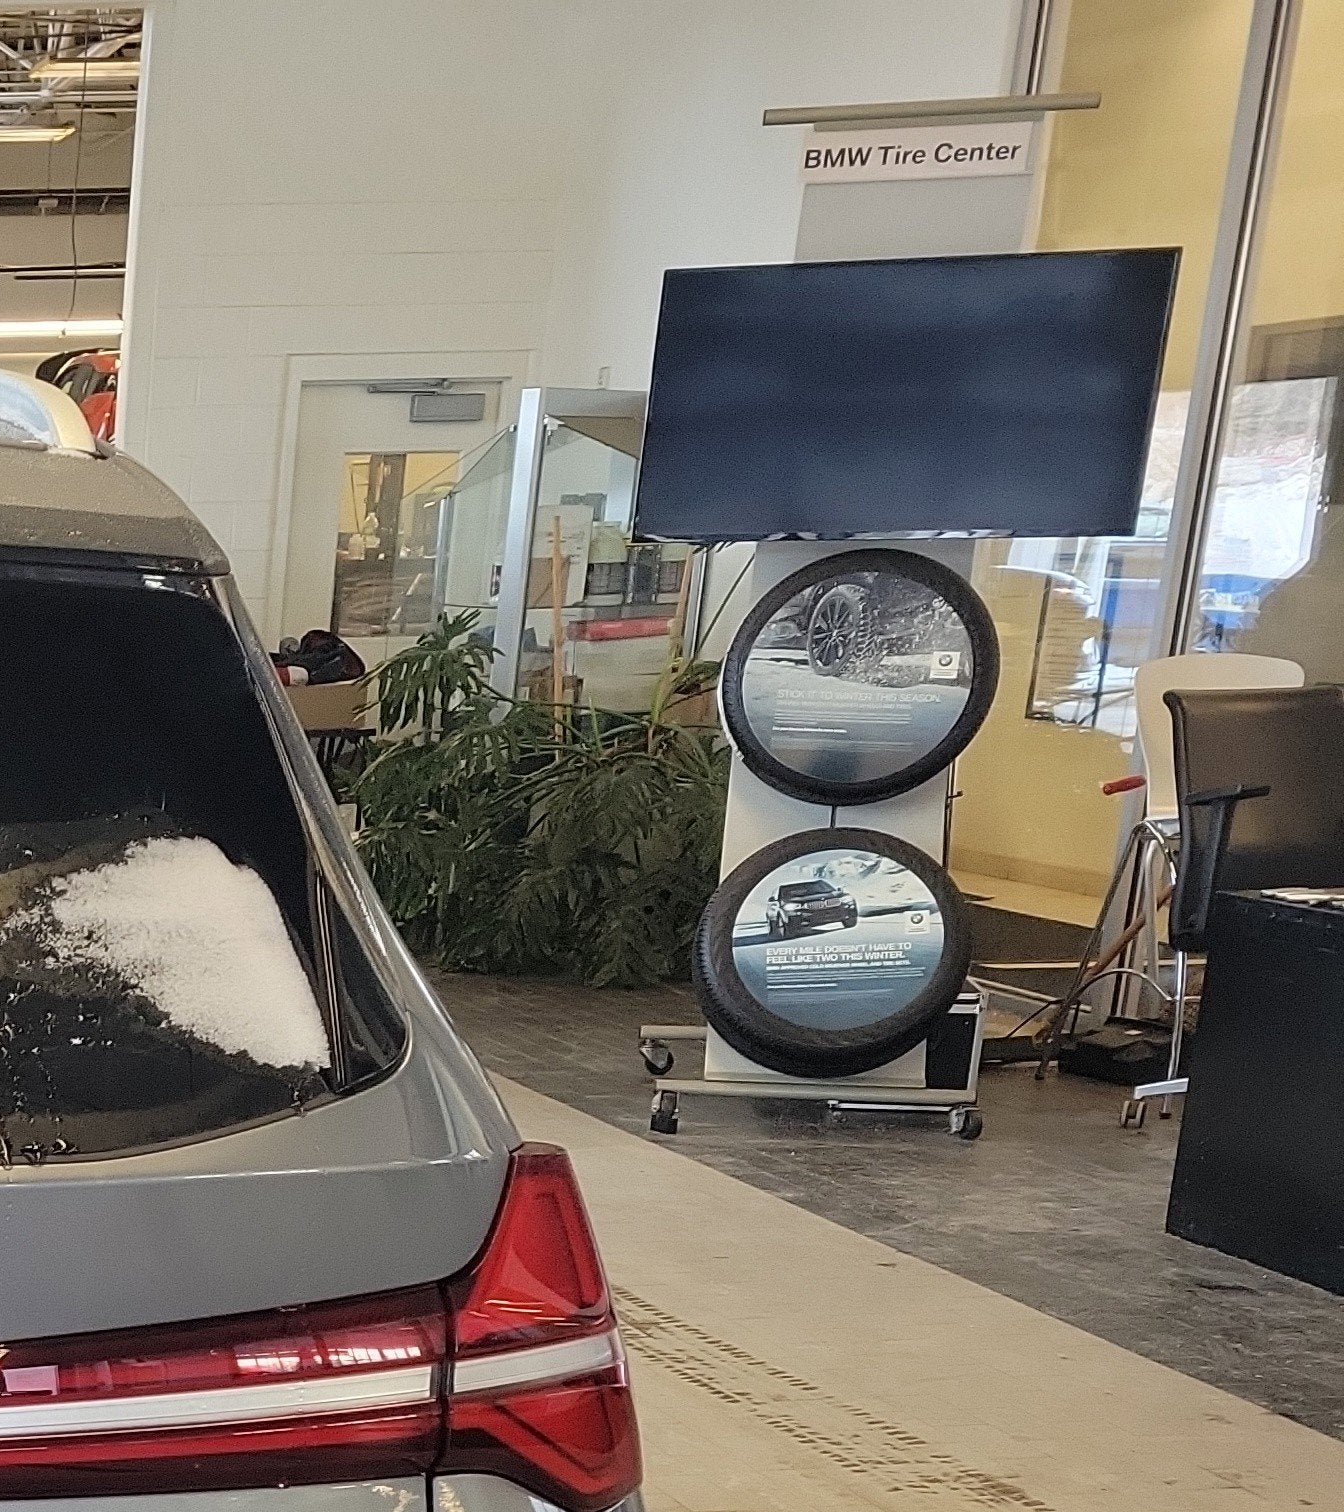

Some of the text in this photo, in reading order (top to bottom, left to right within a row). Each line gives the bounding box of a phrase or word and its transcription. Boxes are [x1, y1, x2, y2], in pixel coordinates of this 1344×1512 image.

[804, 142, 1022, 169] BMW Tire Center
[766, 941, 912, 956] EVERY MILE DOESN'T HAVE TO
[766, 950, 906, 964] FEEL LIKE TWO THIS WINTER.
